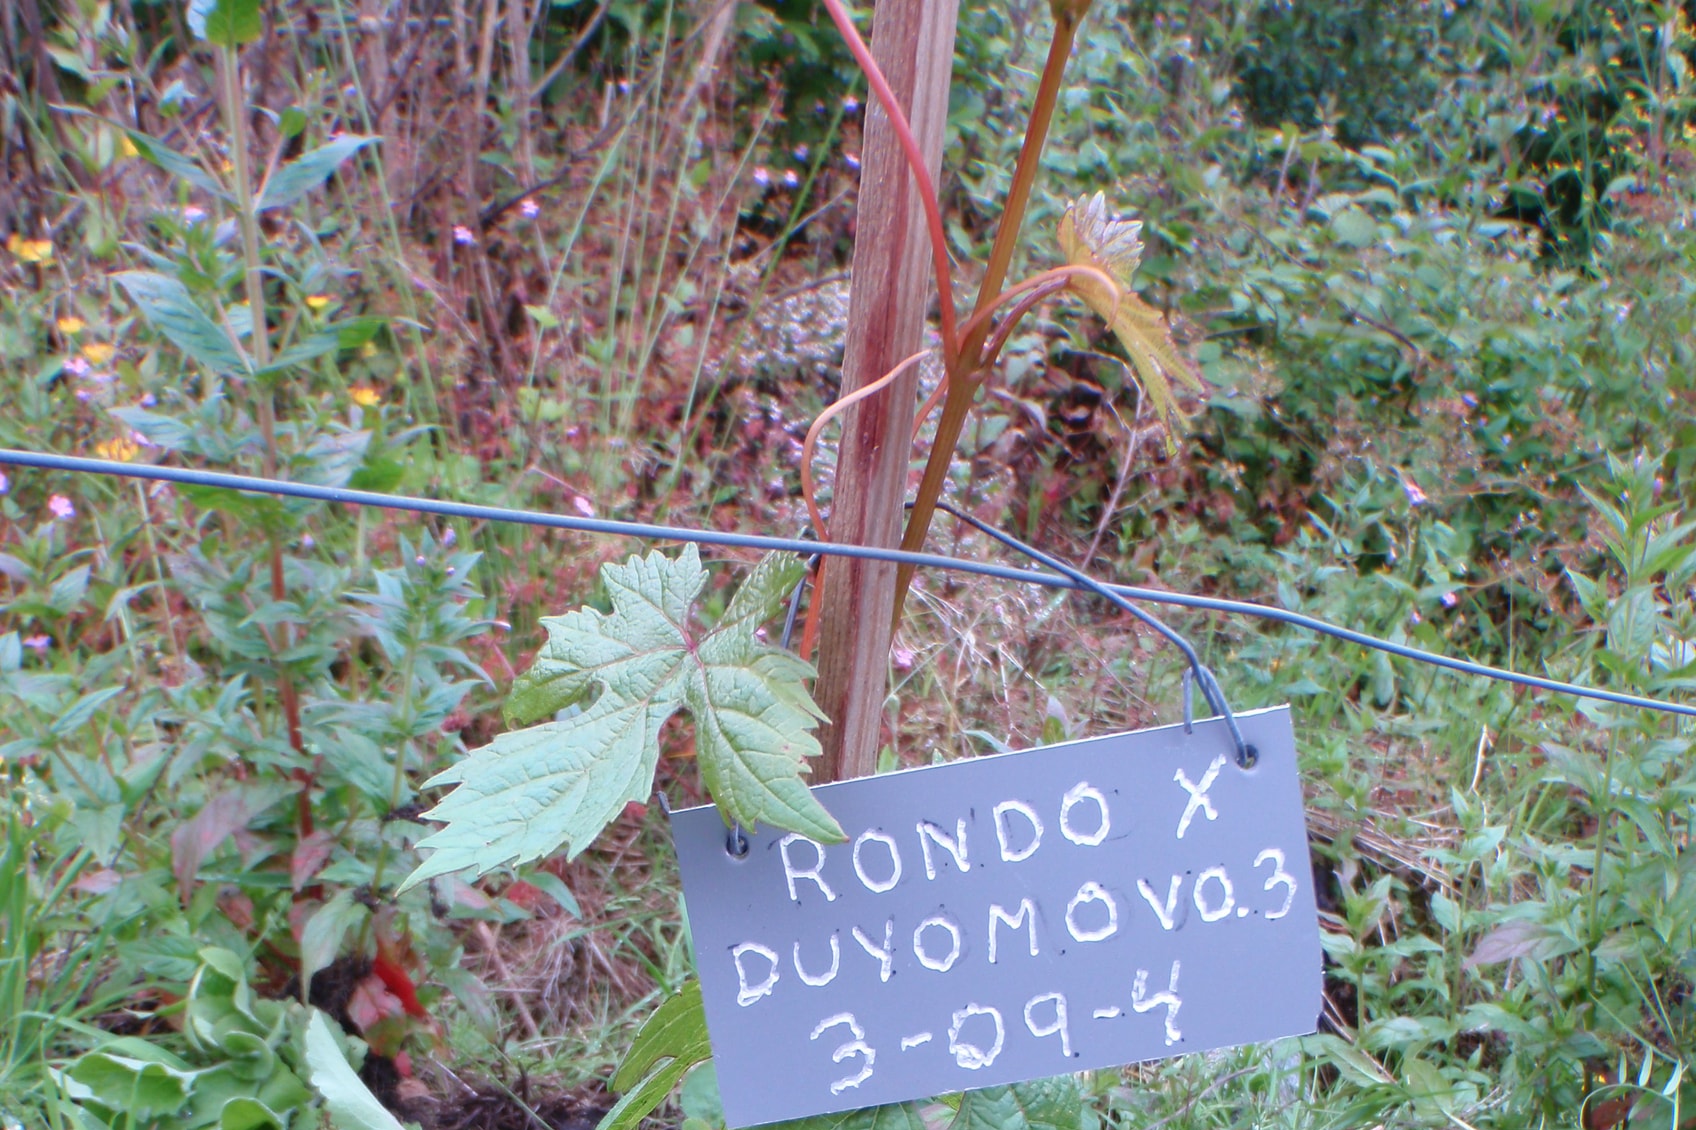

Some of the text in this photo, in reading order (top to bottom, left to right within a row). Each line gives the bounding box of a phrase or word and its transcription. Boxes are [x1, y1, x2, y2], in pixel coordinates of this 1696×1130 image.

[779, 753, 1227, 902] RONDO X
[810, 959, 1183, 1095] 3-09-4
